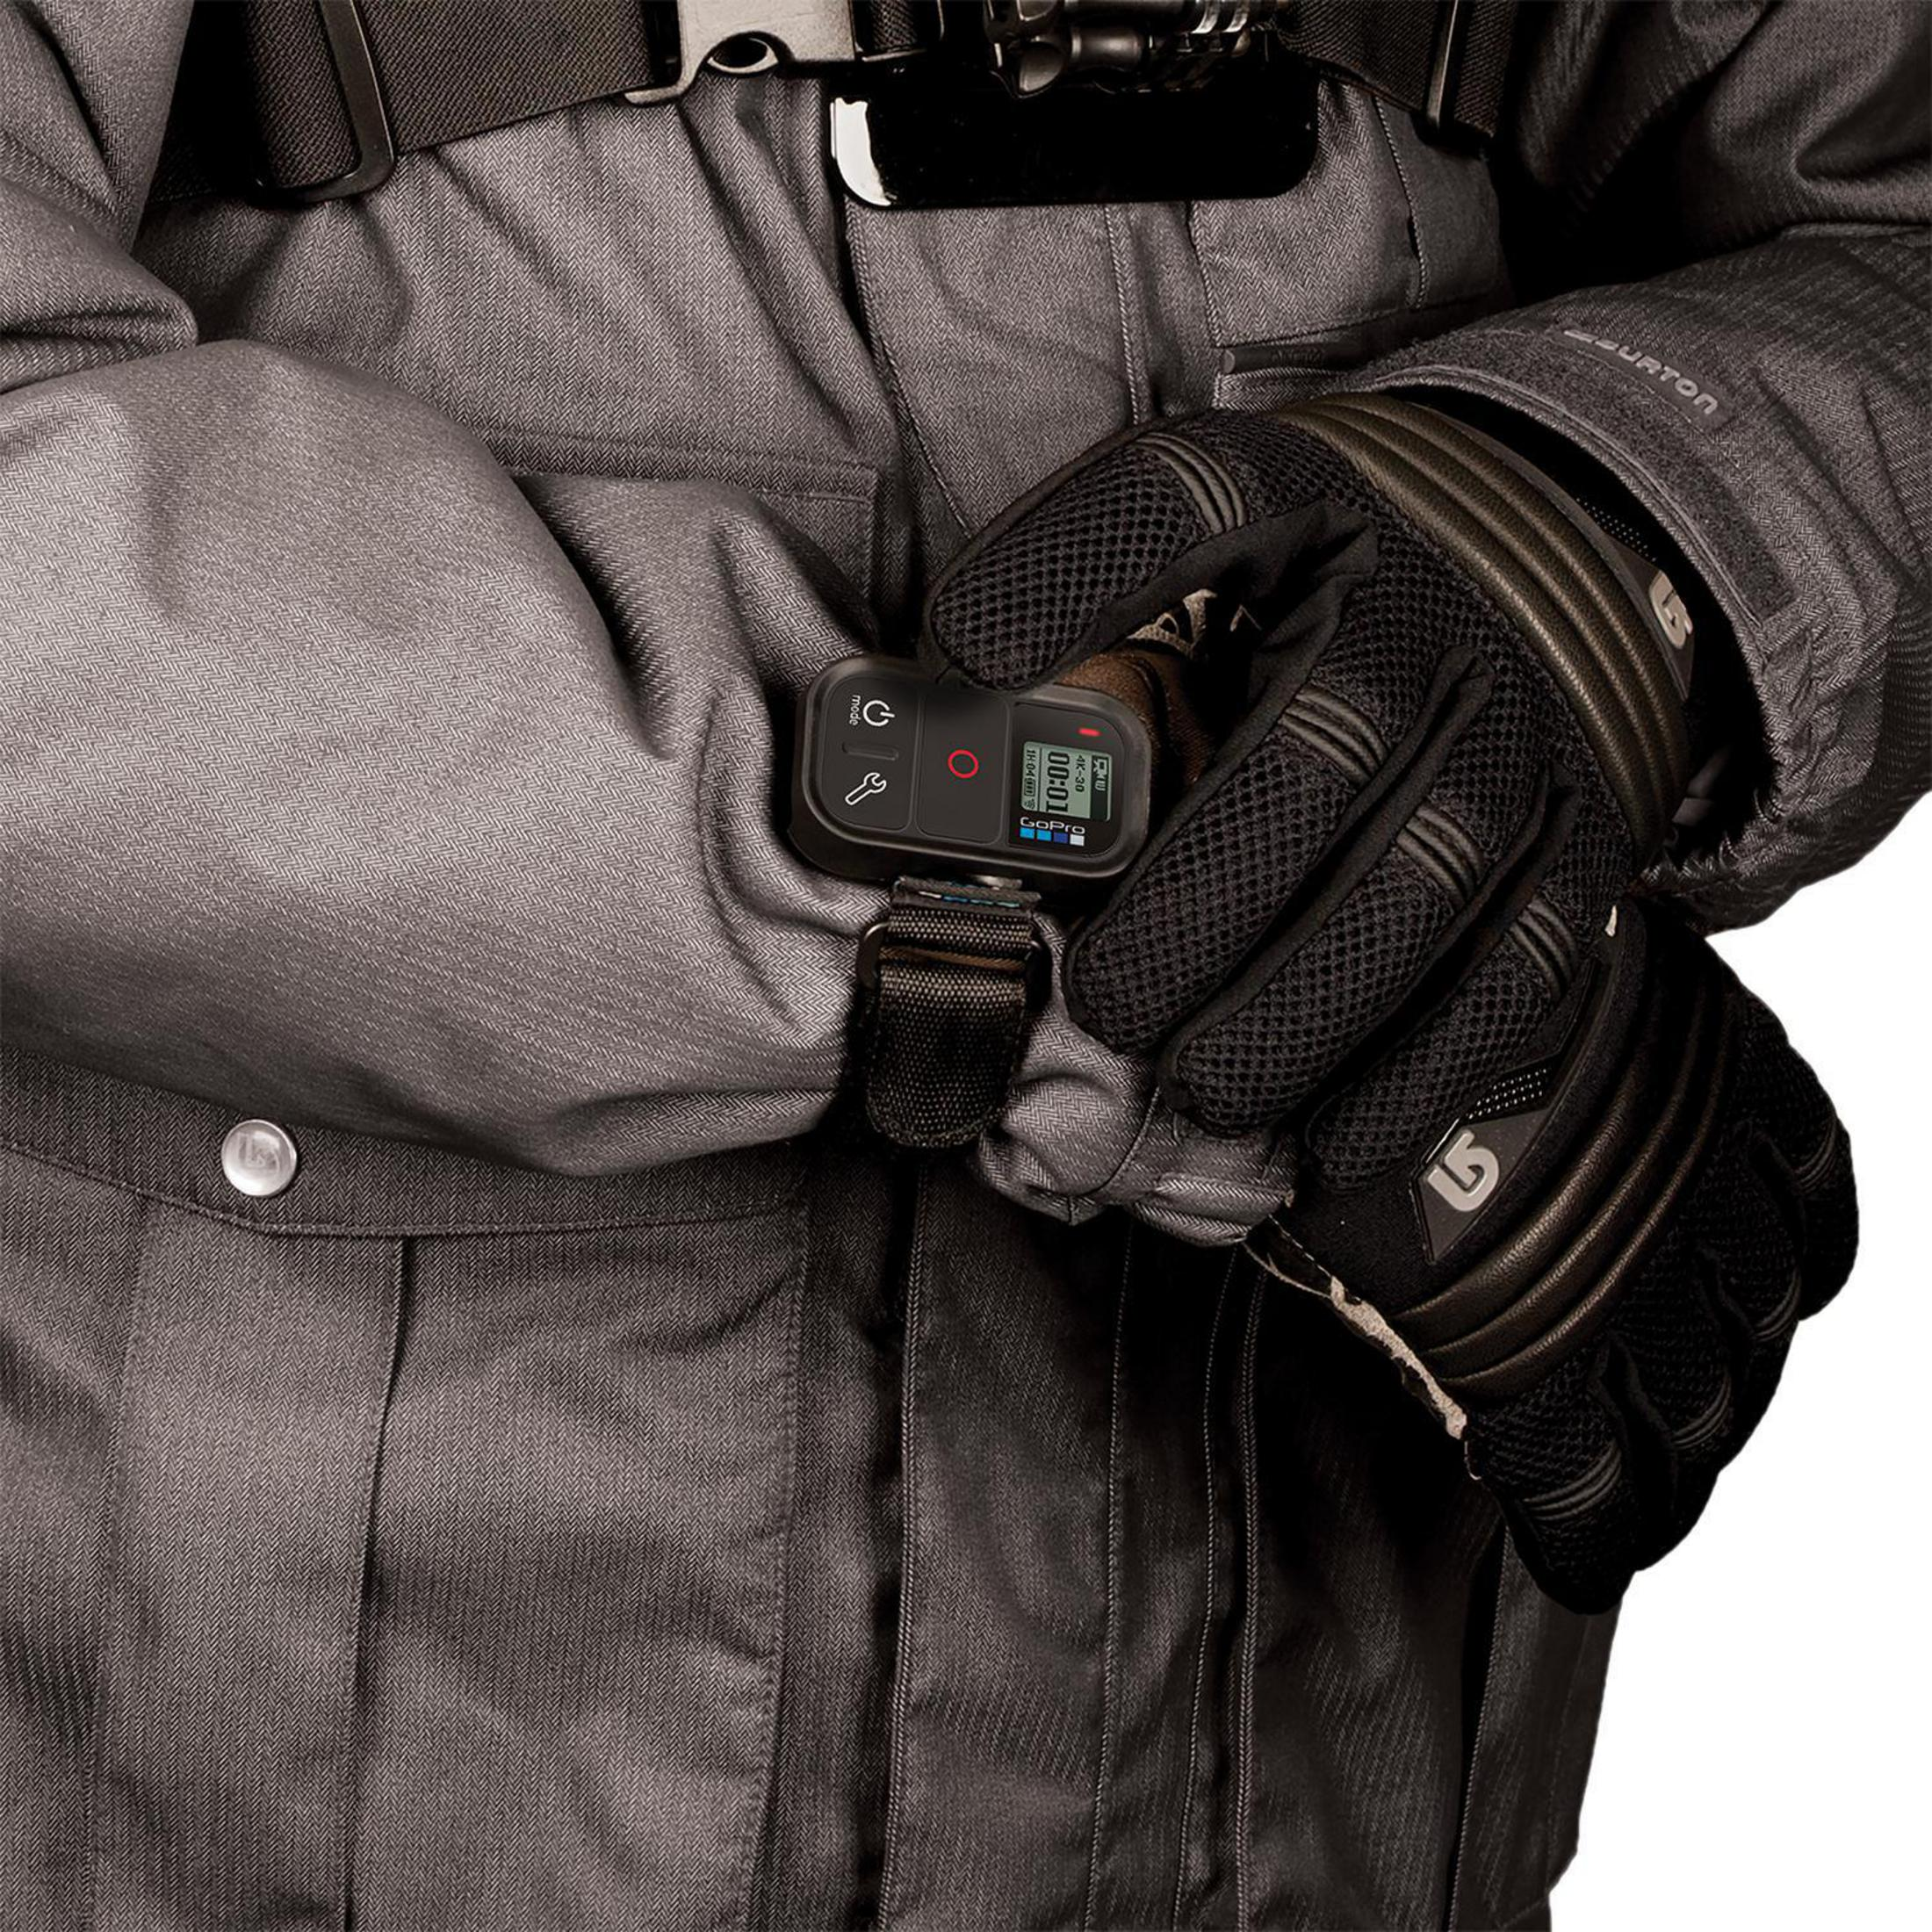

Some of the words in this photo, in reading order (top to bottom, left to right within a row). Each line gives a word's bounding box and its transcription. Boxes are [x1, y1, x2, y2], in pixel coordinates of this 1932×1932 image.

[849, 695, 861, 725] mode
[1046, 751, 1070, 812] 00:01
[1075, 755, 1085, 792] 4K-30
[1020, 817, 1085, 834] GoPro
